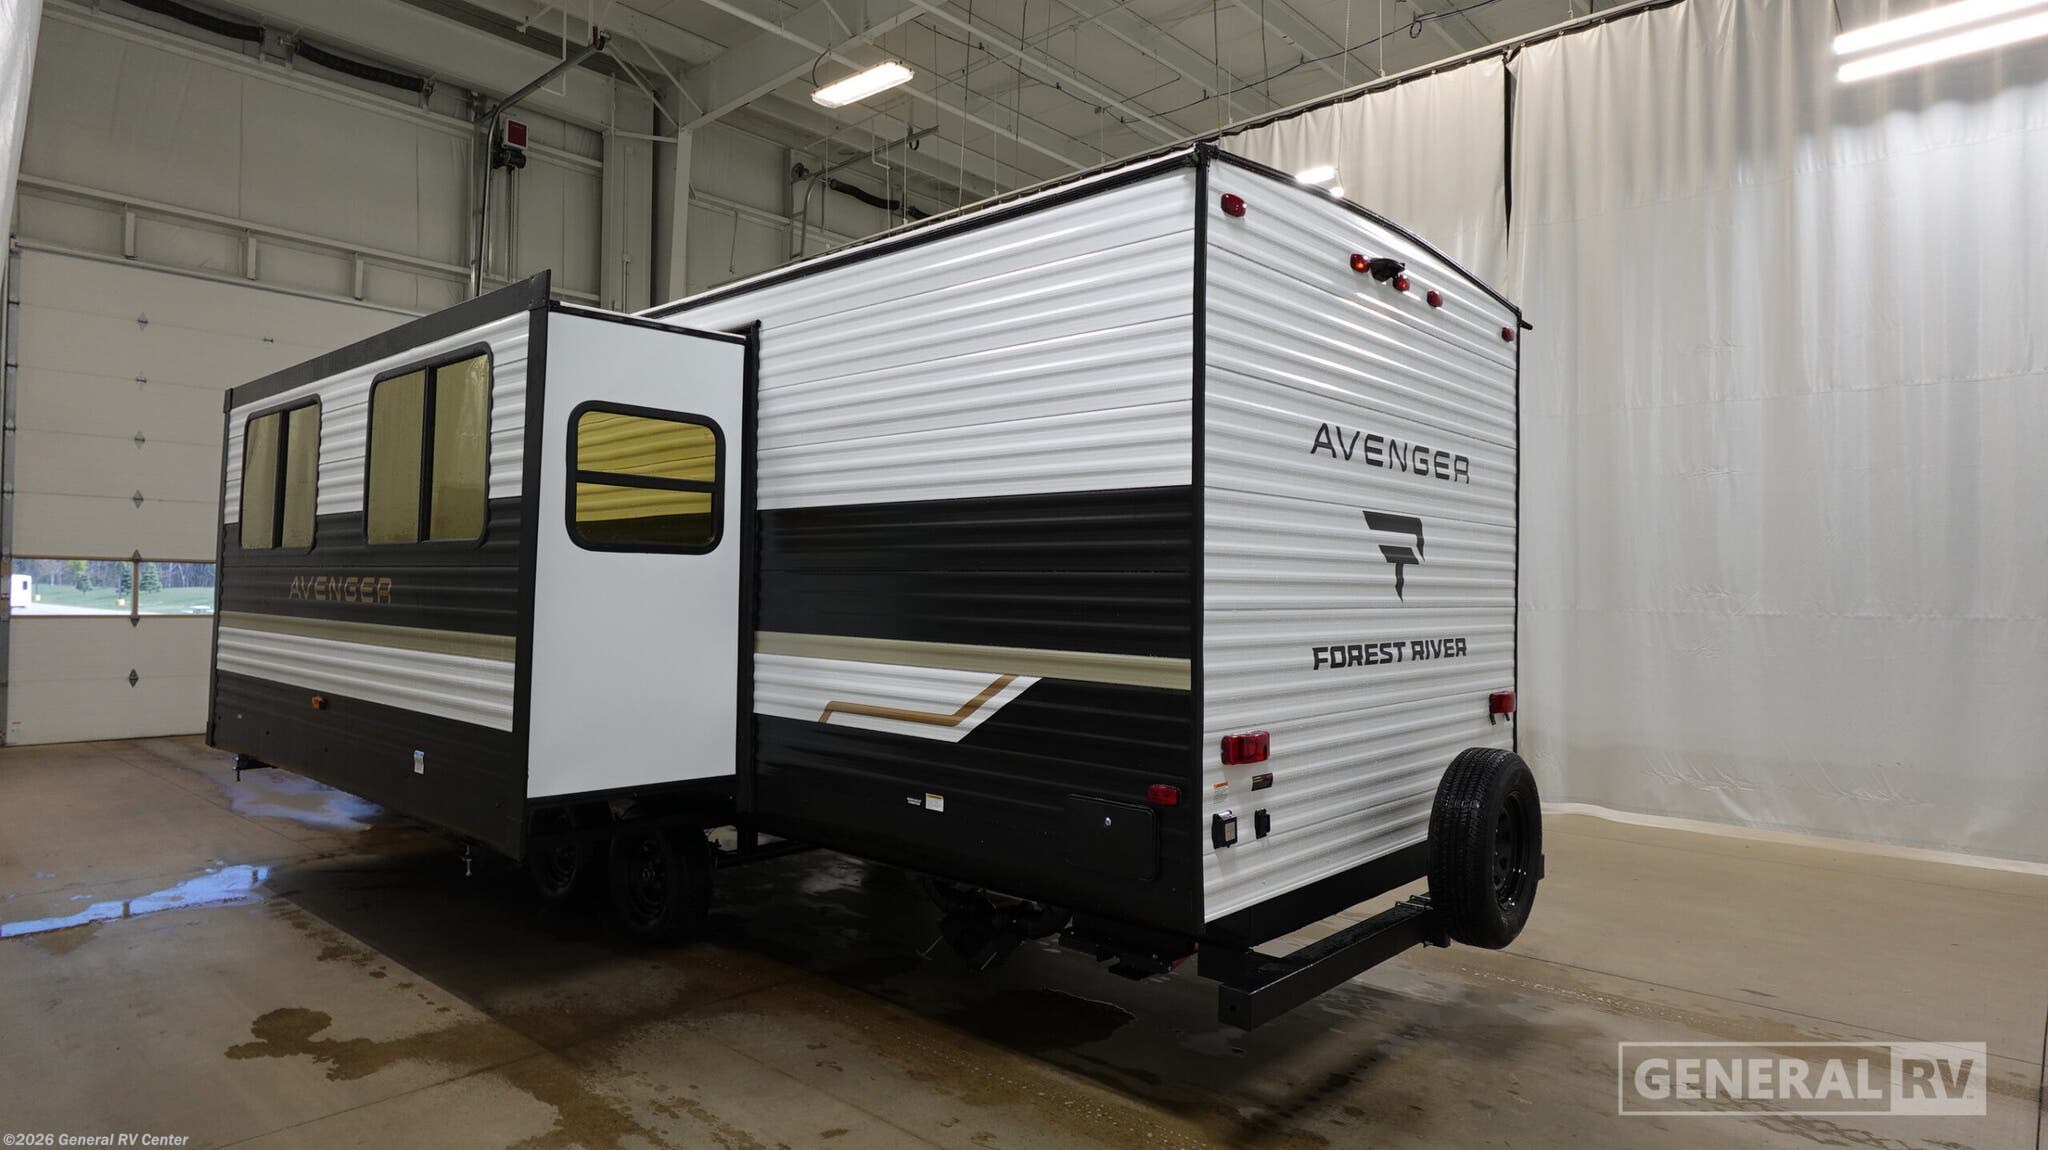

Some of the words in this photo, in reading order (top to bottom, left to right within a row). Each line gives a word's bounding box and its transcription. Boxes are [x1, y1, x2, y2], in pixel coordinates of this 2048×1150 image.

[1310, 423, 1470, 484] AVENGER
[288, 576, 392, 604] AVENGER
[1312, 641, 1406, 671] FOREST
[1410, 637, 1467, 661] RIVER
